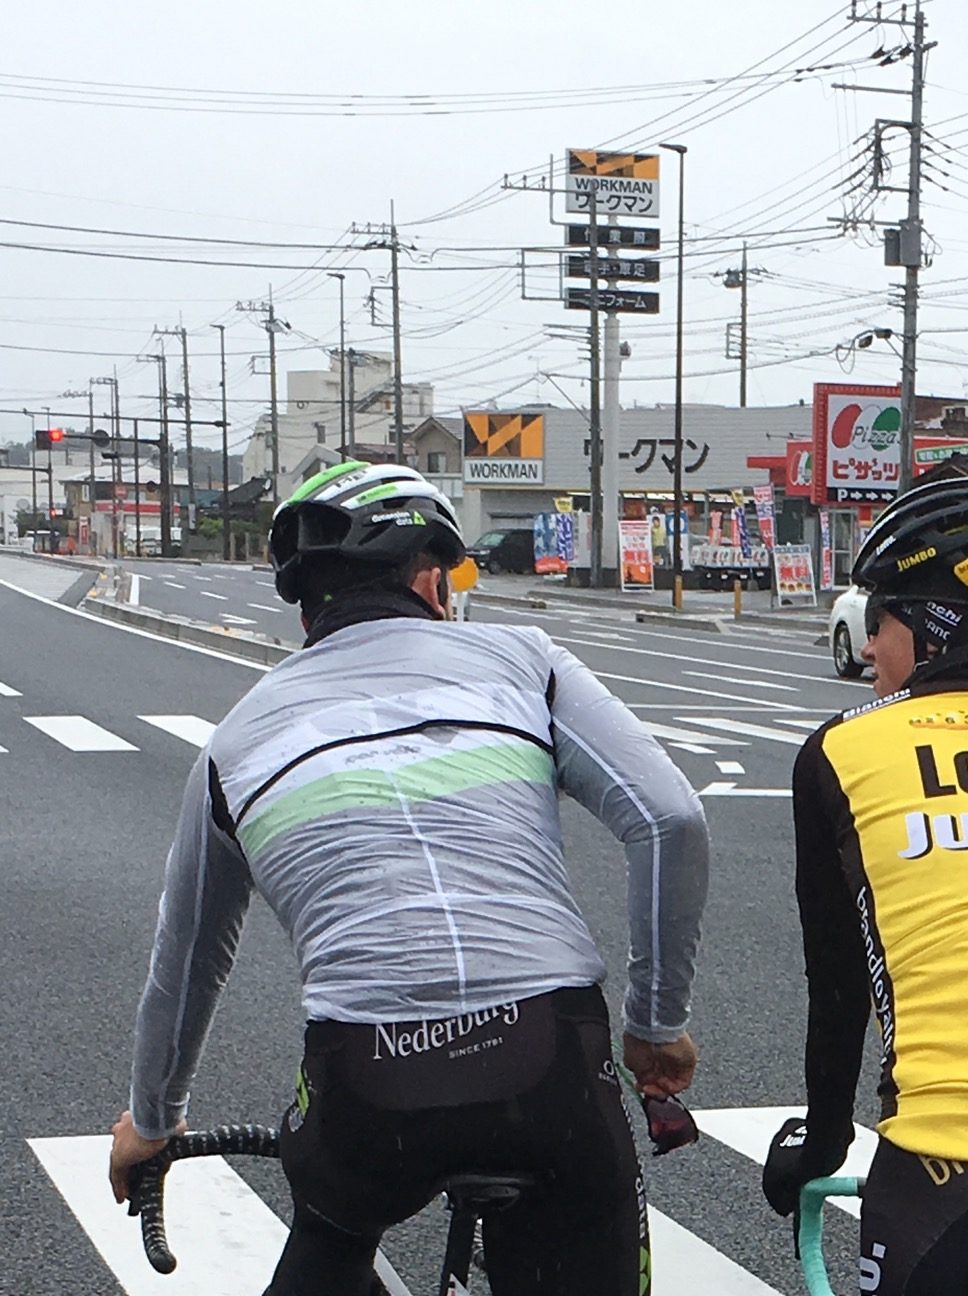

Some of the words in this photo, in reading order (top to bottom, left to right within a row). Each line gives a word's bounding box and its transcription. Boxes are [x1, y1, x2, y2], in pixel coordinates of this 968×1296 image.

[575, 177, 653, 194] WORKMAN
[470, 464, 538, 479] WORKMAN
[837, 489, 849, 502] P
[897, 547, 937, 572] JUMBO
[373, 1001, 519, 1060] Nederburg
[449, 1043, 481, 1059] SINCE
